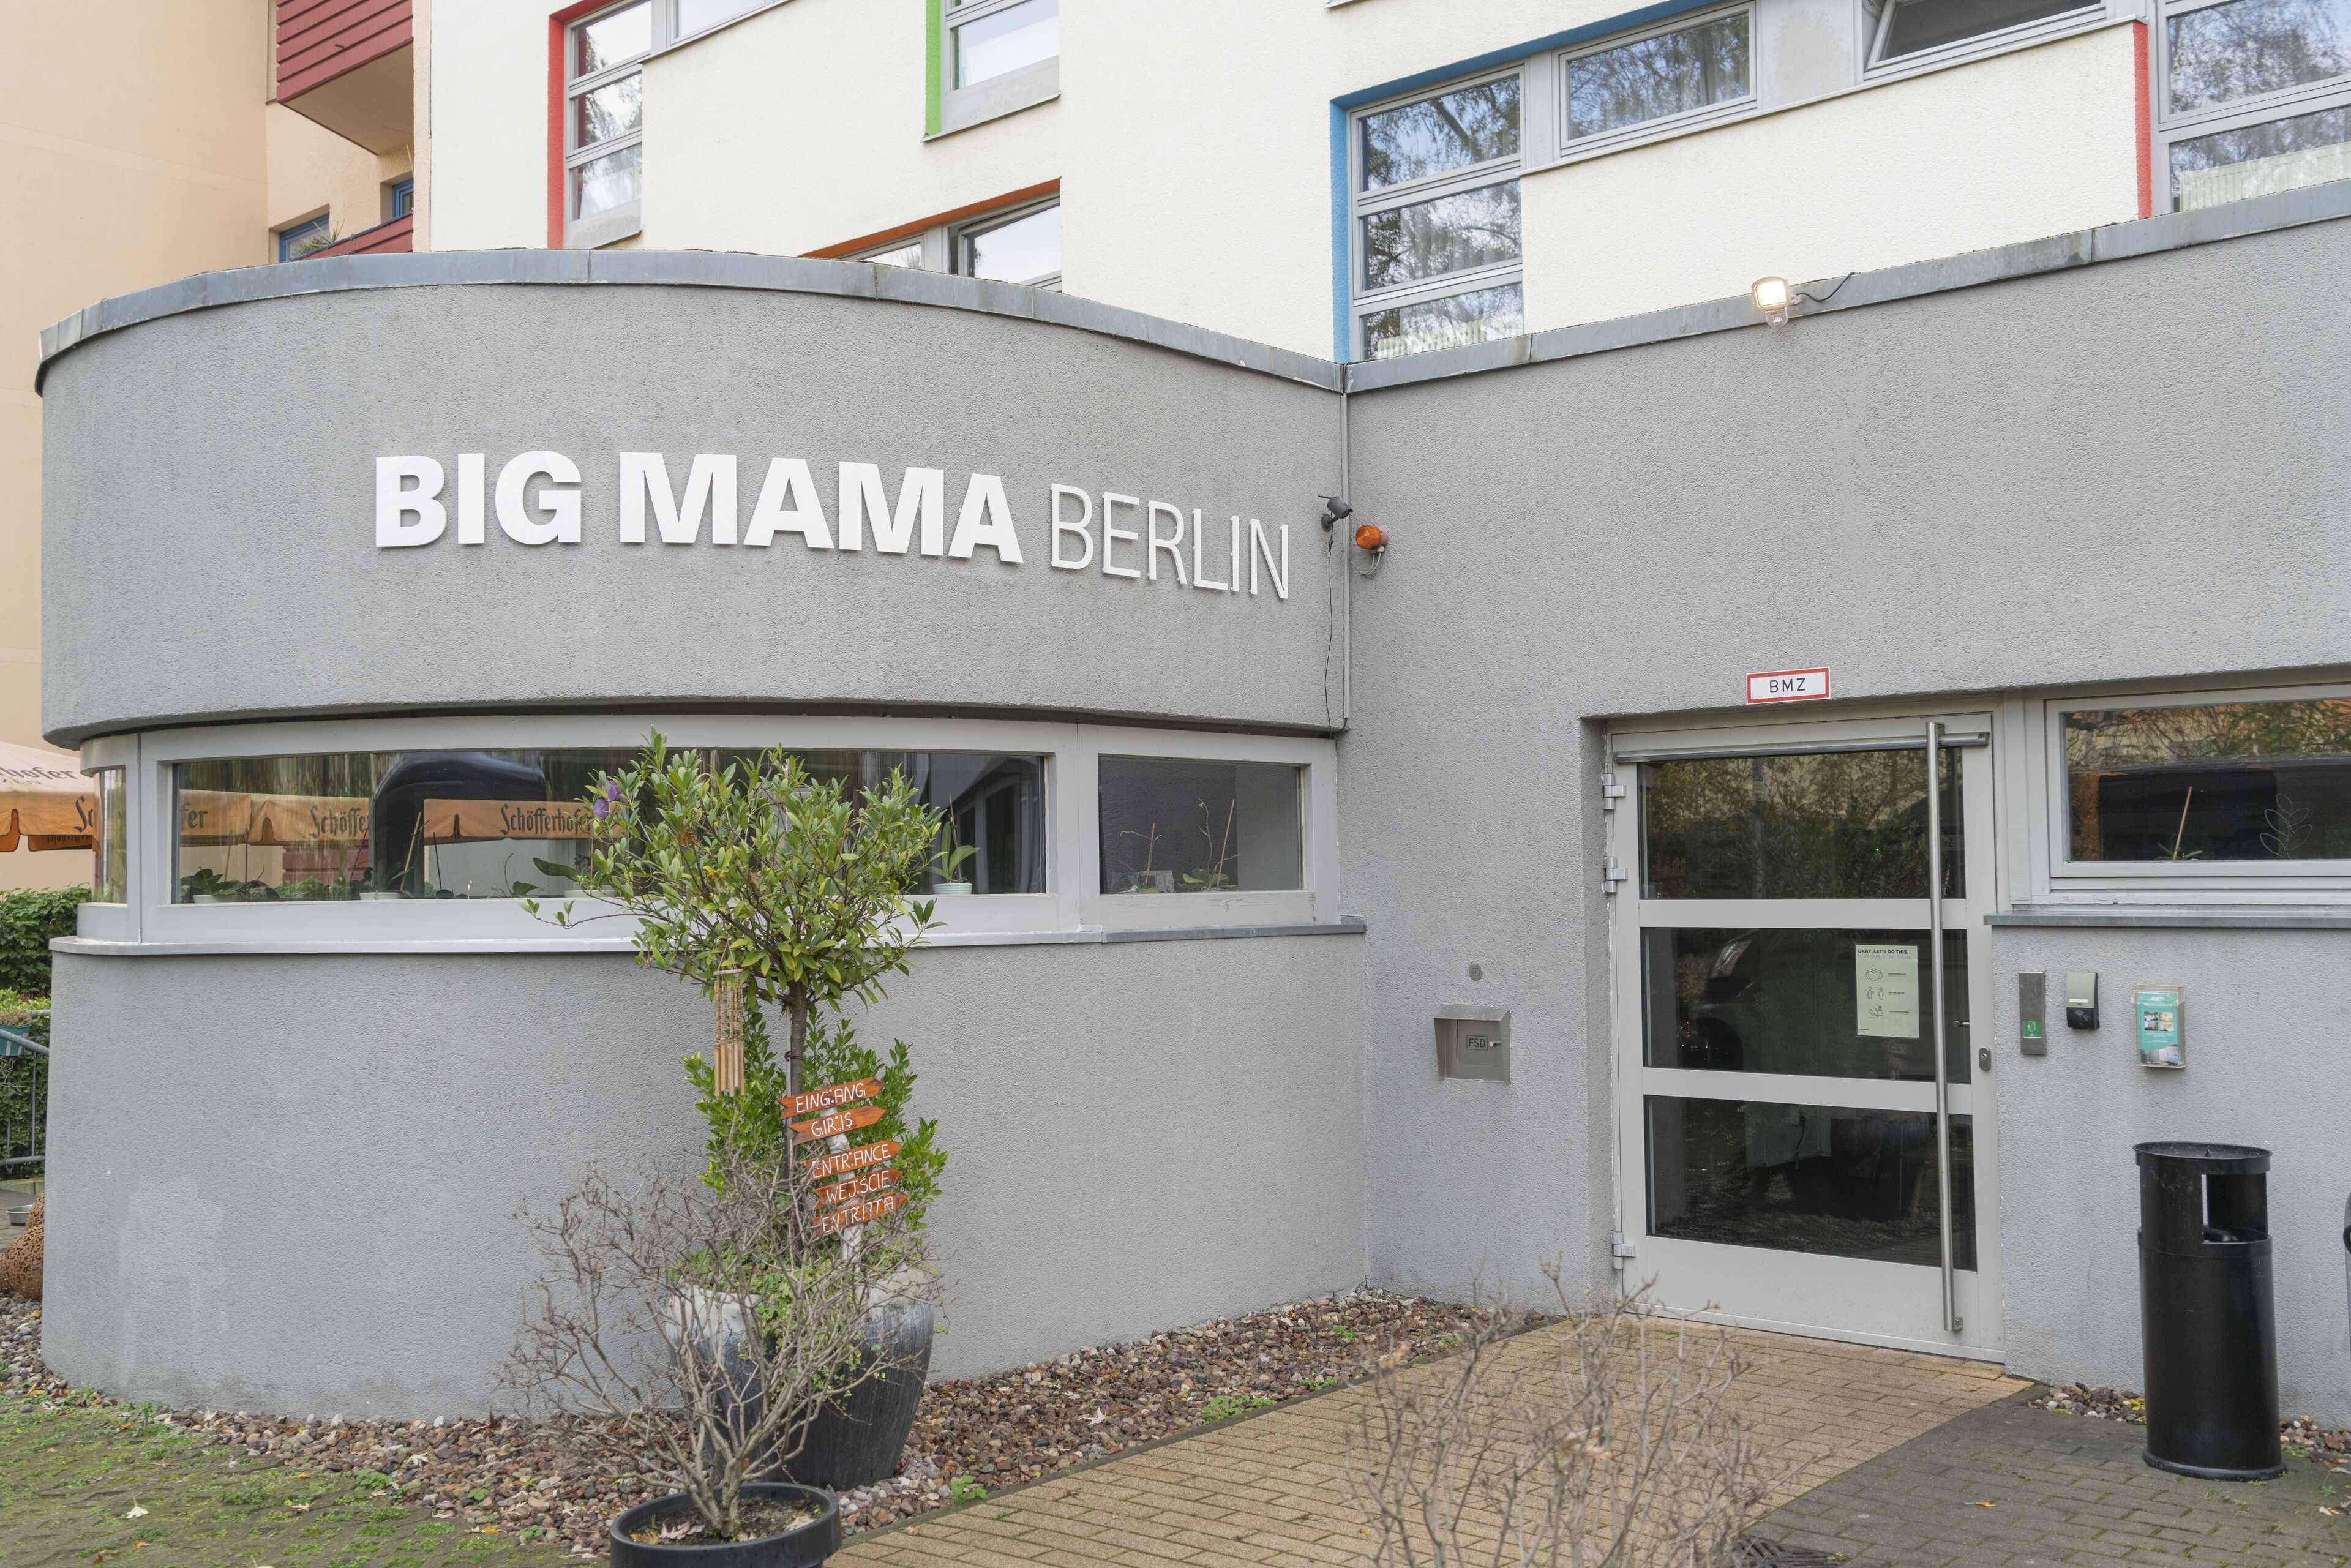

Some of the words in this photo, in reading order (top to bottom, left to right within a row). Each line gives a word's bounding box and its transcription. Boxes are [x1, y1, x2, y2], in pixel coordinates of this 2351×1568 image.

[376, 450, 582, 547] BIG
[620, 451, 1024, 563] MAMA
[1051, 482, 1289, 600] BERLIN
[1769, 677, 1806, 693] BMZ
[309, 804, 369, 839] Schöffe
[1469, 1038, 1486, 1048] FSD
[795, 1082, 866, 1114] EINGANG
